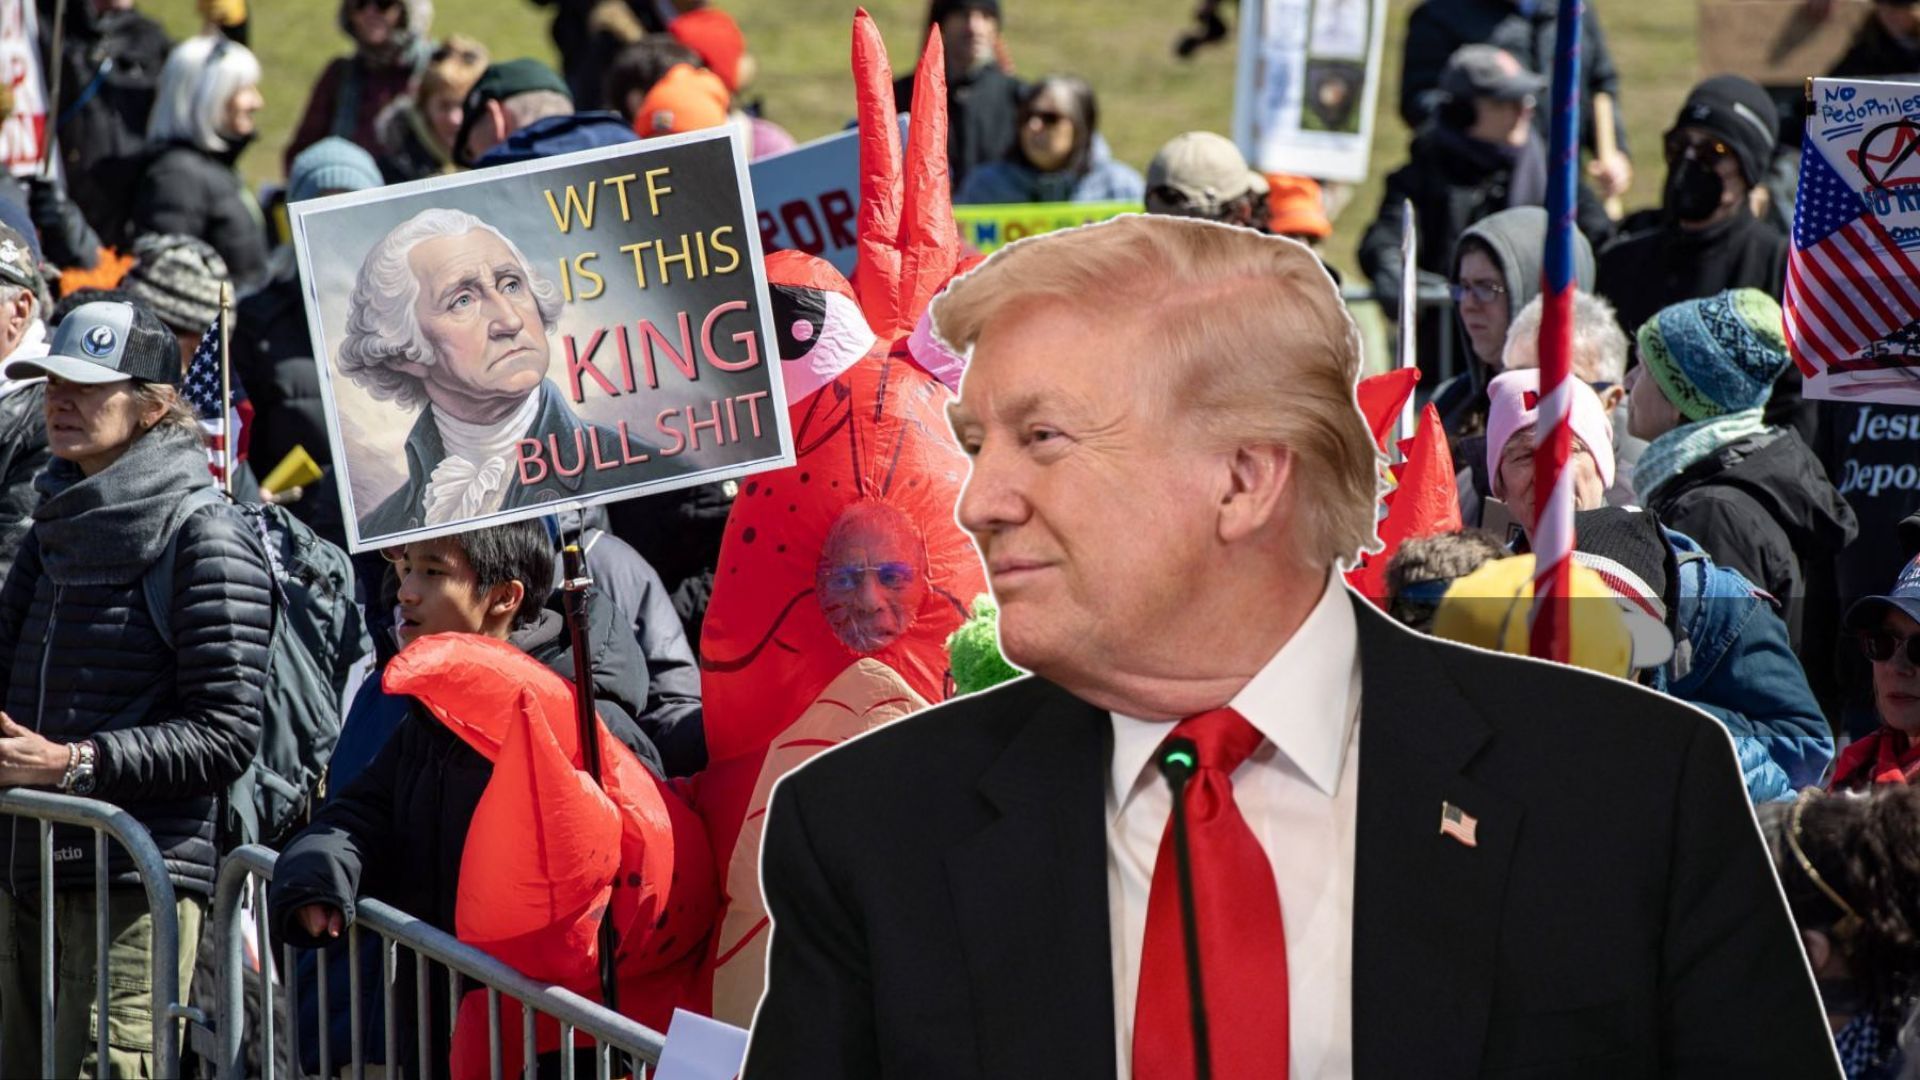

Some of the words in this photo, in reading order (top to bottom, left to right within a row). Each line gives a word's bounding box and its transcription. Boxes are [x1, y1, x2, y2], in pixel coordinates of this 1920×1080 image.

[1824, 86, 1856, 102] NO
[544, 166, 672, 234] WTF
[559, 251, 605, 303] IS
[620, 225, 740, 289] THIS
[563, 300, 760, 402] KING
[515, 420, 648, 485] BULL
[656, 390, 769, 456] SHIT
